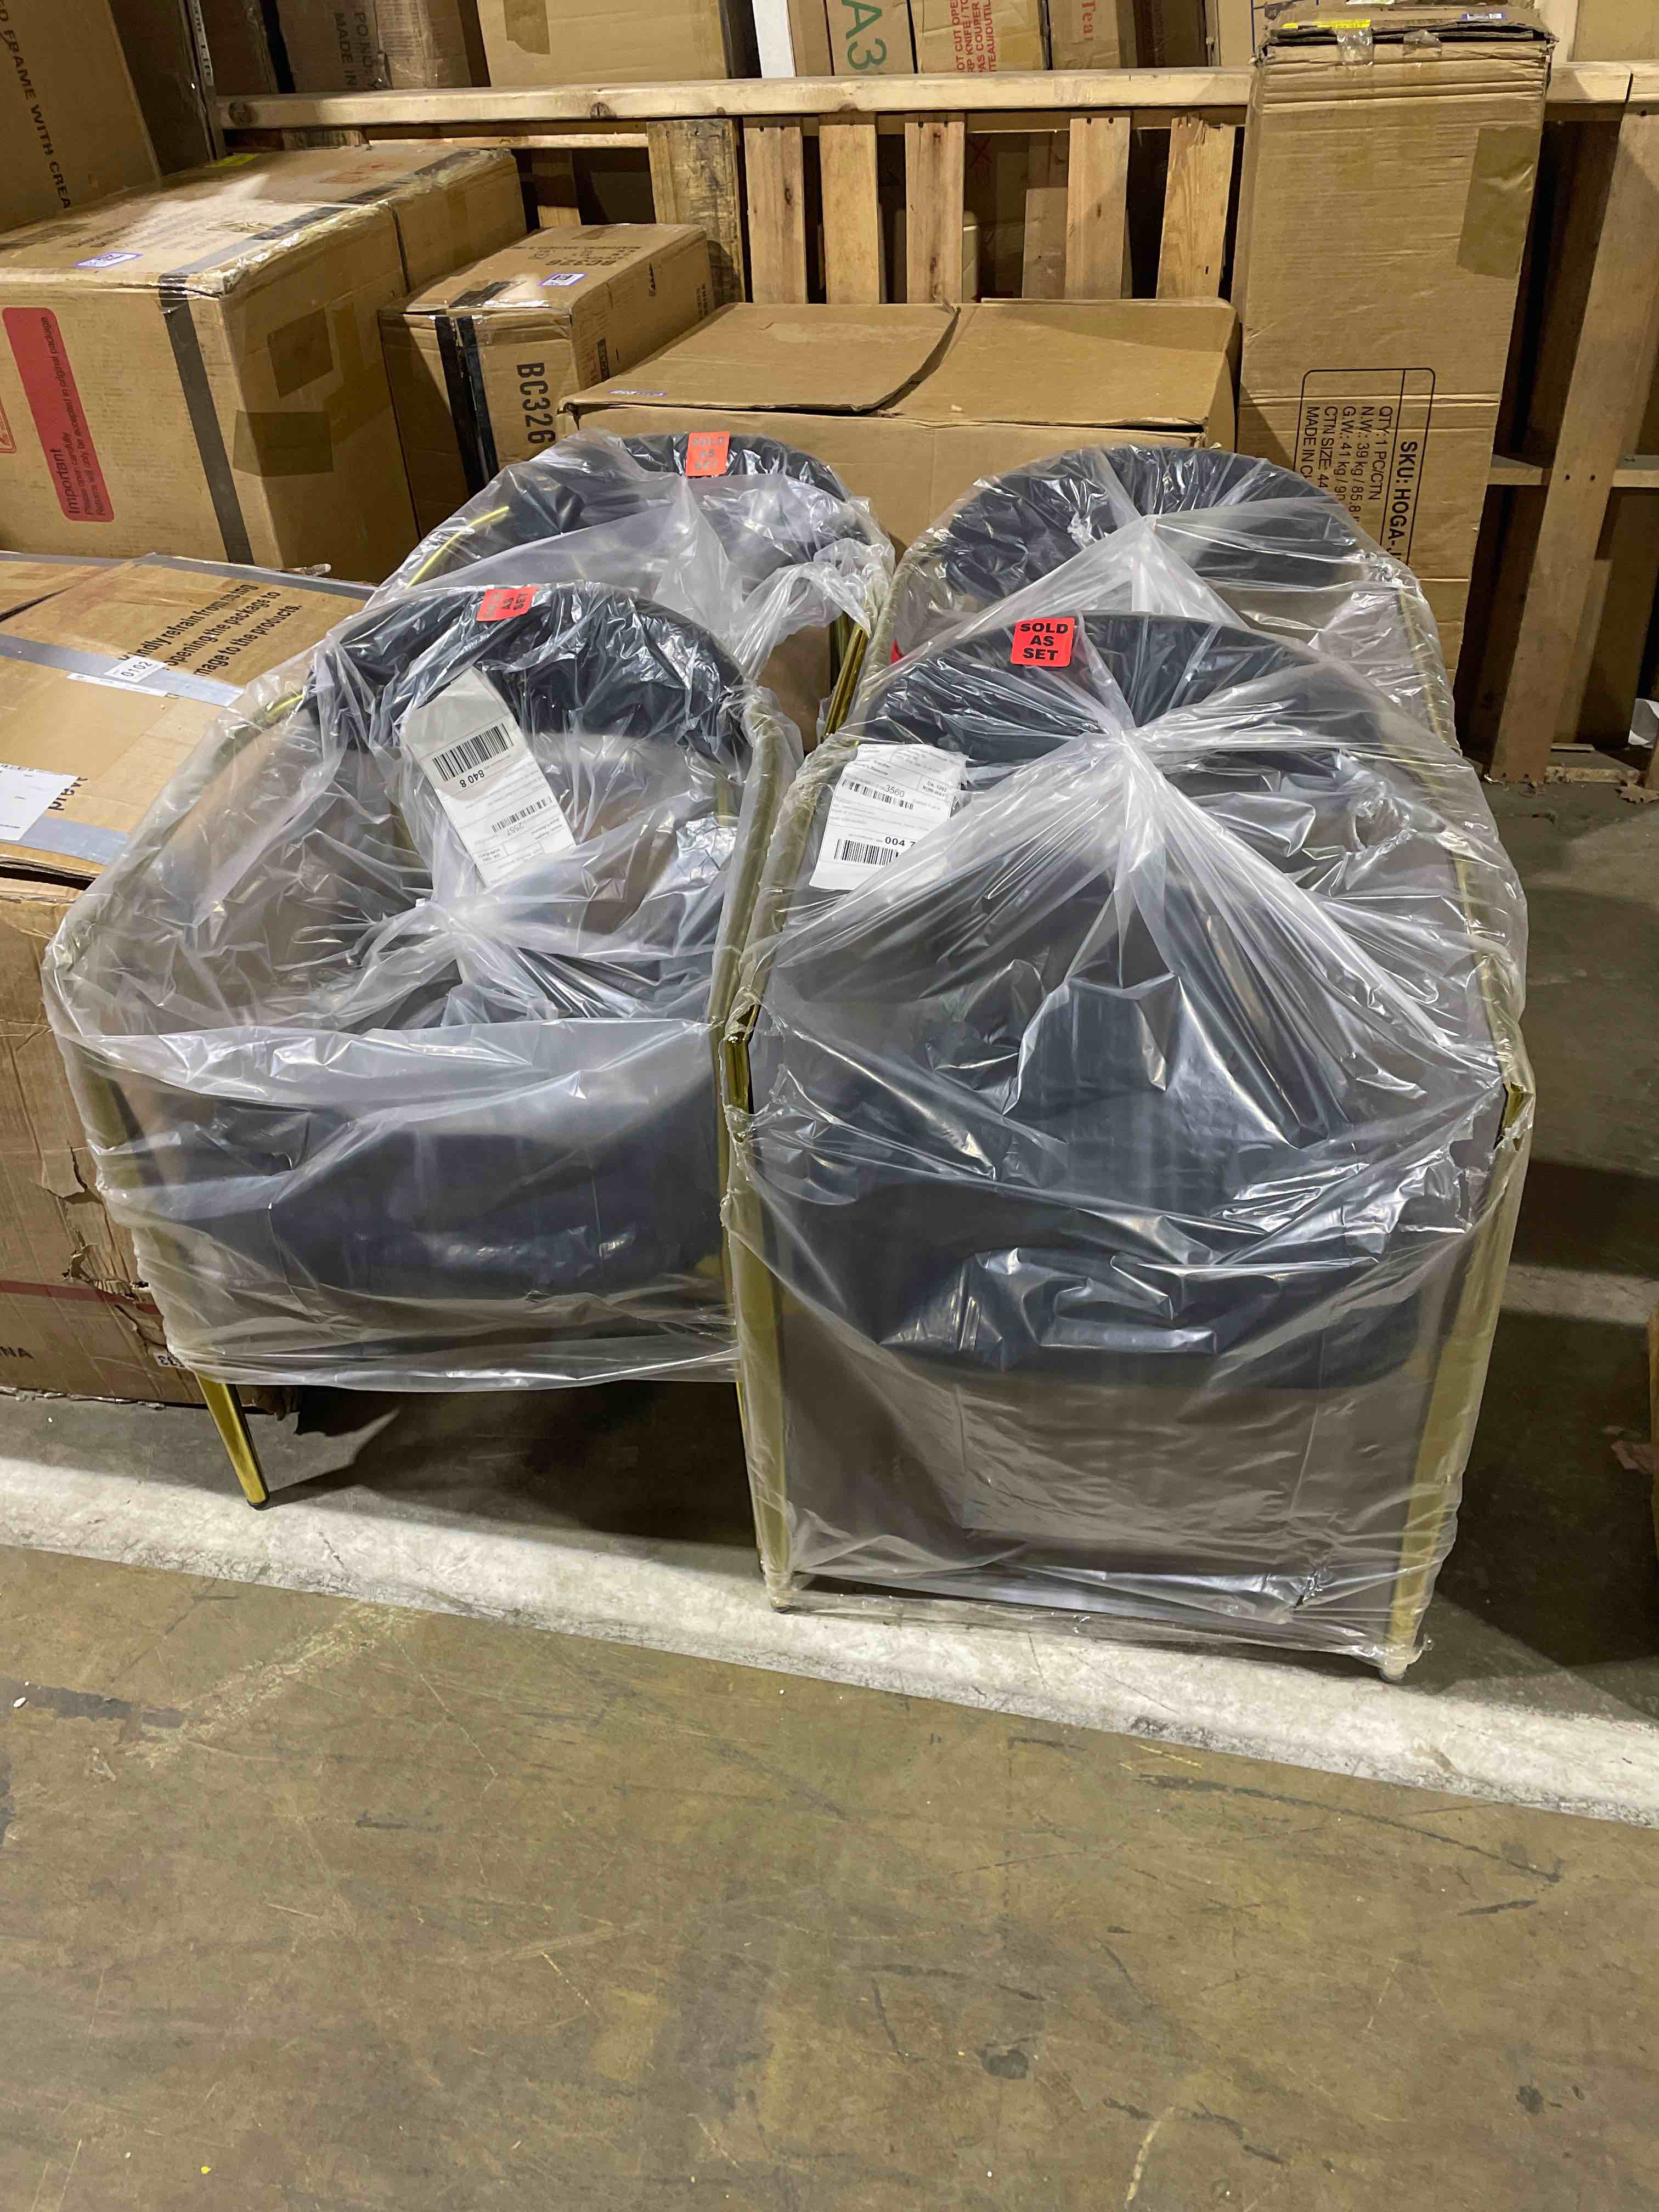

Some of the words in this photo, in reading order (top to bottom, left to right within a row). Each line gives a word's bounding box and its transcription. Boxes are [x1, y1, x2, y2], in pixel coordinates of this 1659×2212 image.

[842, 0, 887, 70] A3
[953, 30, 963, 52] CUT
[962, 20, 974, 55] KNIFE
[972, 2, 984, 51] COUPER
[983, 0, 996, 72] TEAU/OUTIL
[334, 13, 353, 64] MADE
[344, 70, 358, 86] IN
[956, 55, 966, 72] OT
[977, 55, 986, 72] AS
[3, 30, 36, 100] FRAME
[30, 104, 54, 155] WITH
[49, 161, 71, 208] CREA
[41, 317, 59, 356] package
[51, 356, 66, 387] original
[63, 398, 82, 436] accepted
[517, 362, 556, 443] BC326
[1303, 407, 1320, 447] MADE
[1323, 406, 1338, 435] CTN
[1301, 449, 1315, 462] IN
[1318, 437, 1334, 470] SIZE:
[1339, 442, 1352, 457] 41
[1356, 443, 1369, 458] 39
[1394, 441, 1418, 483] SKU:
[49, 448, 80, 514] Important
[1333, 461, 1350, 476] kg
[1351, 461, 1367, 476] kg
[1368, 452, 1387, 500] PC/CTN
[1348, 486, 1364, 512] 85.8
[1386, 488, 1412, 560] HOGA-J
[501, 597, 514, 610] AS
[513, 593, 528, 610] SET
[161, 615, 205, 639] refrain
[192, 601, 229, 616] from
[167, 635, 219, 667] opening
[202, 624, 232, 636] the
[223, 599, 270, 625] package
[217, 646, 241, 655] to
[229, 634, 258, 646] the
[250, 605, 303, 635] products.
[1020, 623, 1069, 634] SOLD
[1023, 647, 1058, 661] SET
[1029, 635, 1054, 646] AS
[121, 661, 153, 677] 0102
[460, 779, 467, 788] 8
[467, 770, 486, 784] 840
[885, 836, 905, 847] 004
